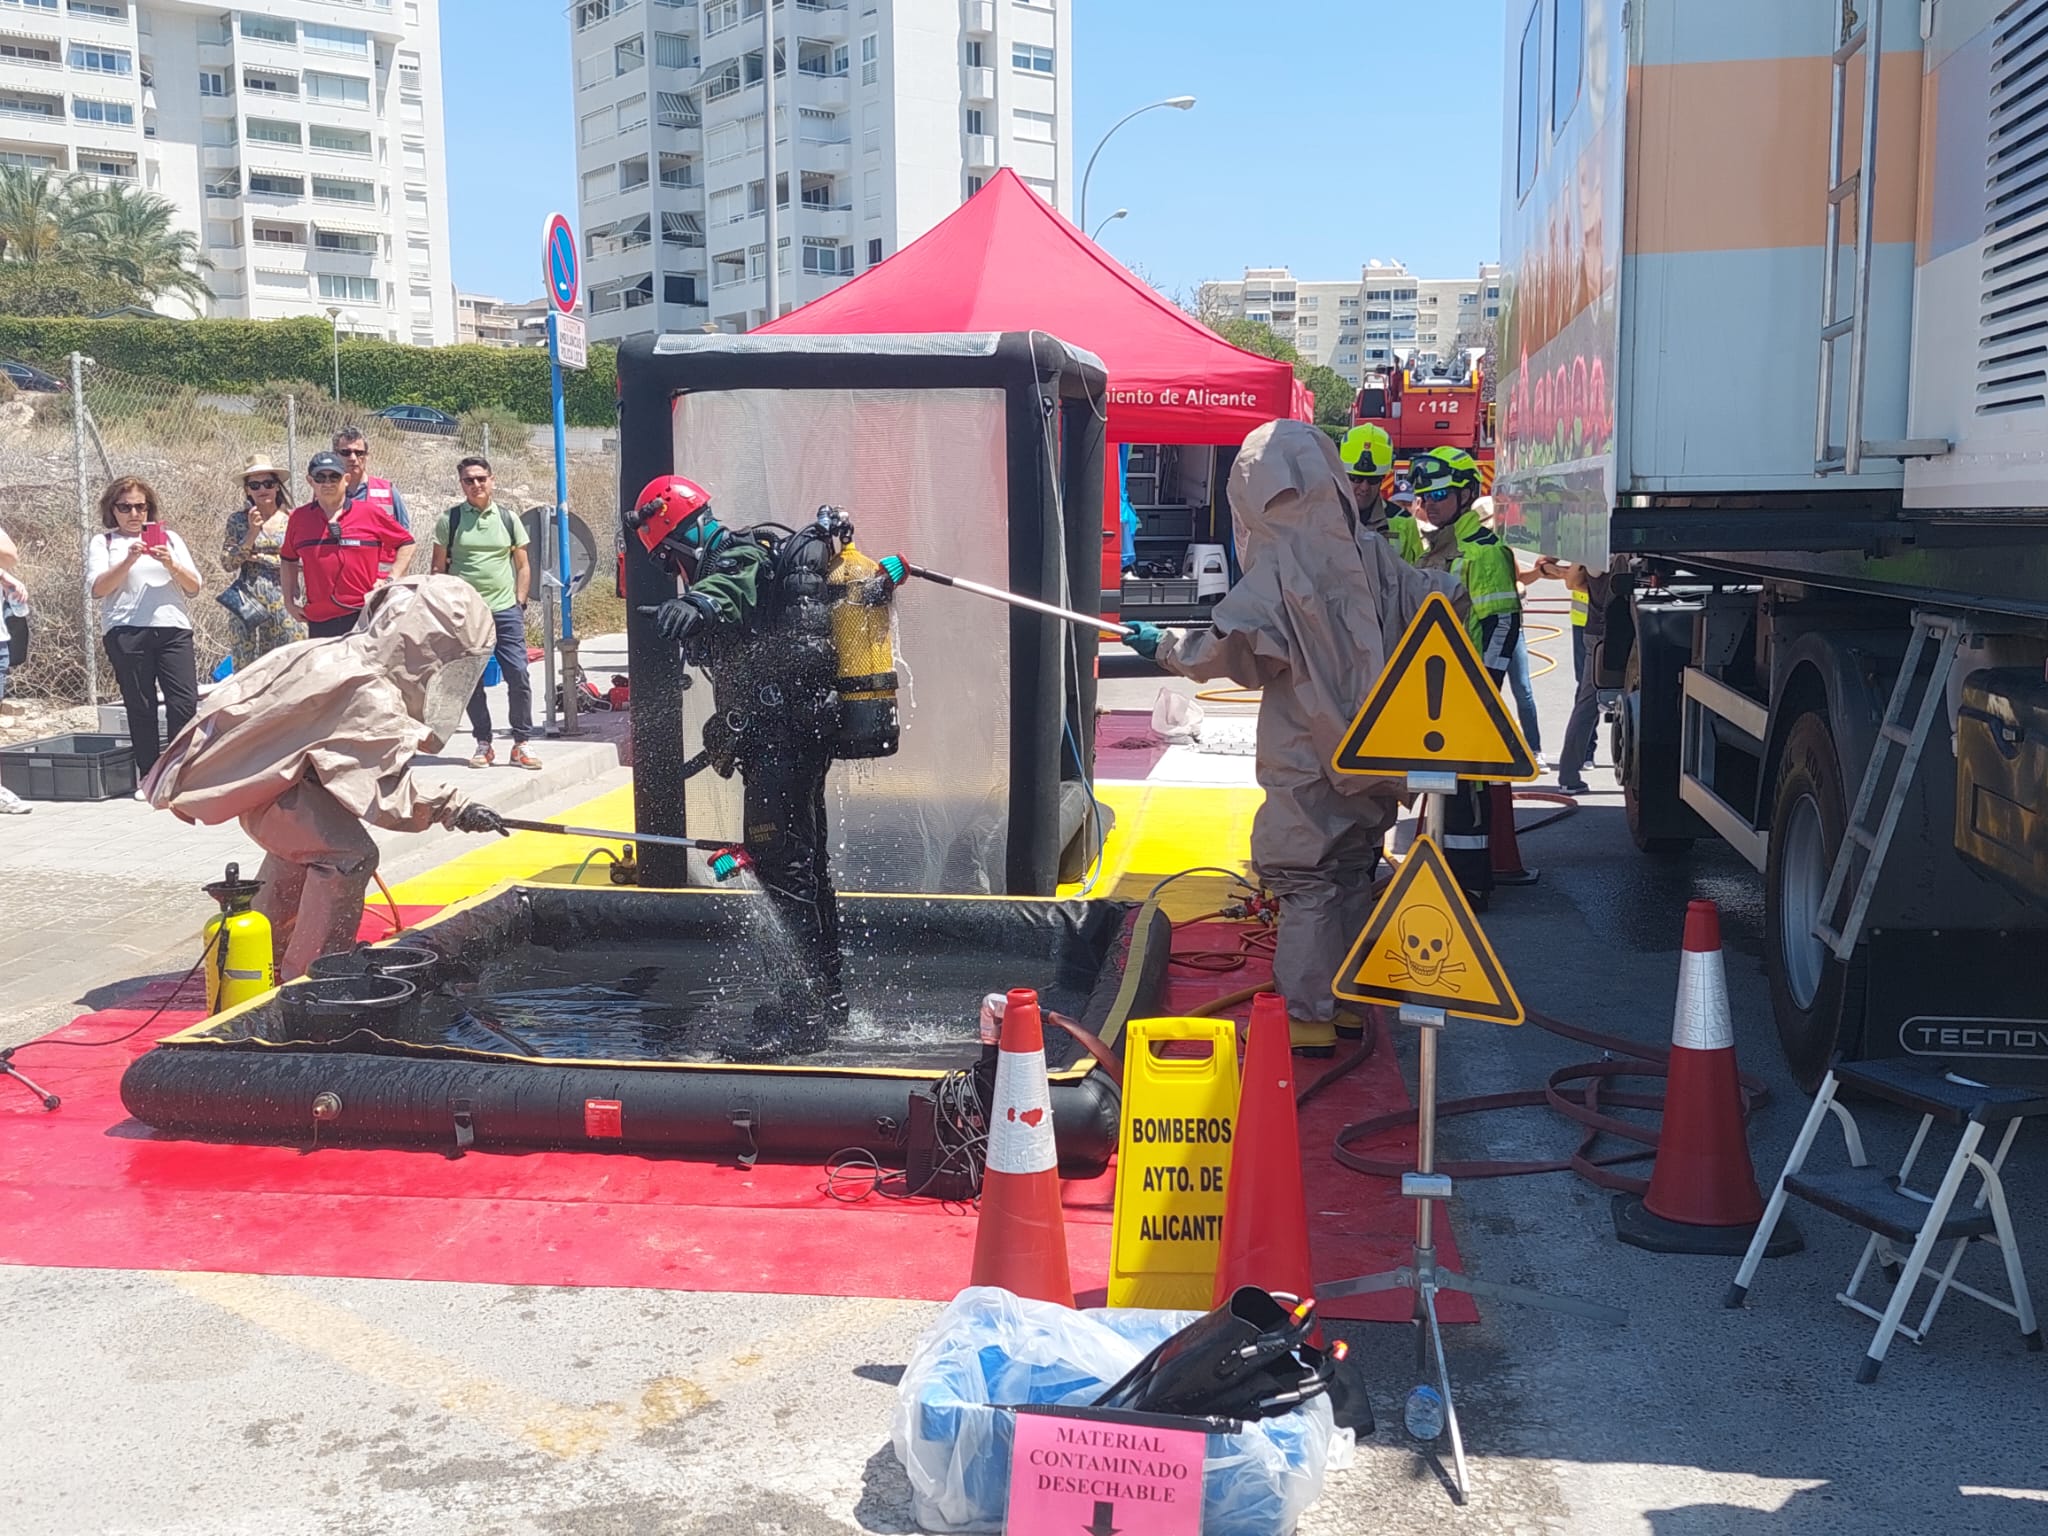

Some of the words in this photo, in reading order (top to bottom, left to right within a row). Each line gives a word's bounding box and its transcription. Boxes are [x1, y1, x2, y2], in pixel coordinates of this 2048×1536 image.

[1160, 388, 1179, 405] de
[1185, 388, 1257, 407] Alicante
[1428, 400, 1459, 413] 112
[1132, 1117, 1232, 1144] BOMBEROS
[1142, 1166, 1194, 1192] AYTO.
[1200, 1166, 1223, 1192] DE
[1056, 1427, 1166, 1454] MATERIAL
[1029, 1449, 1188, 1480] CONTAMINADO
[1037, 1474, 1176, 1503] DESECHABLE
